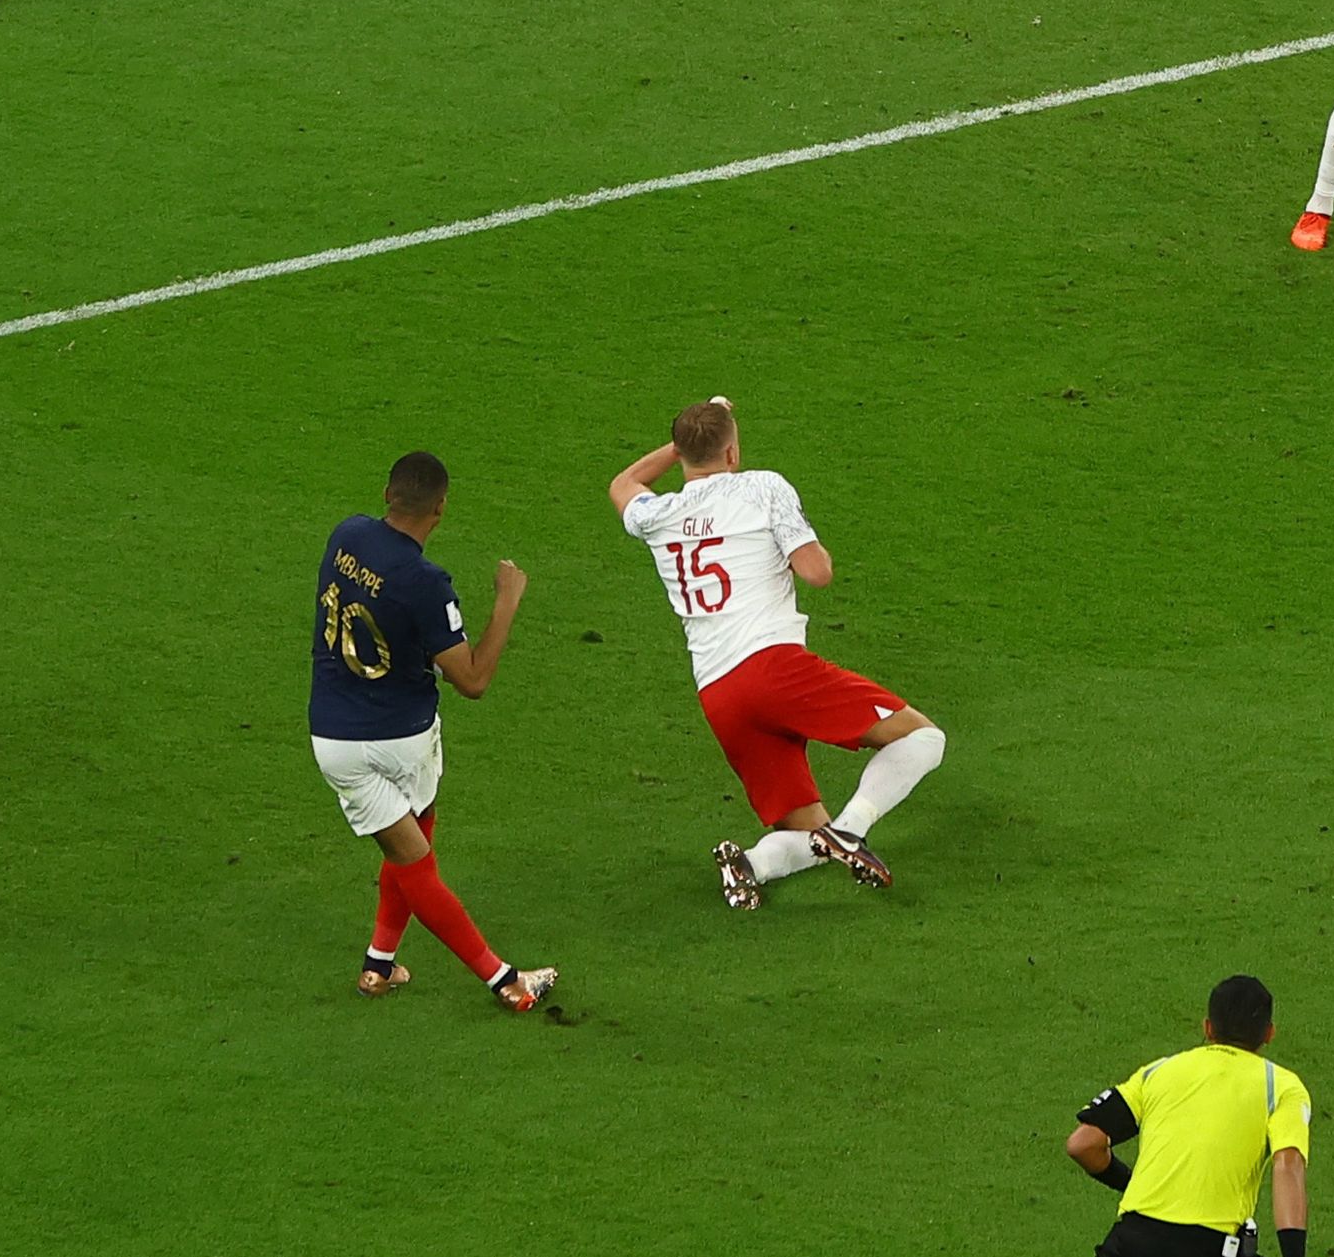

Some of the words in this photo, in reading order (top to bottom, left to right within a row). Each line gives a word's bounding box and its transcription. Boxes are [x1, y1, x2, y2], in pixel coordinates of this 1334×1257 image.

[683, 517, 714, 537] GLIK
[666, 536, 732, 615] 15
[320, 582, 391, 680] 10
